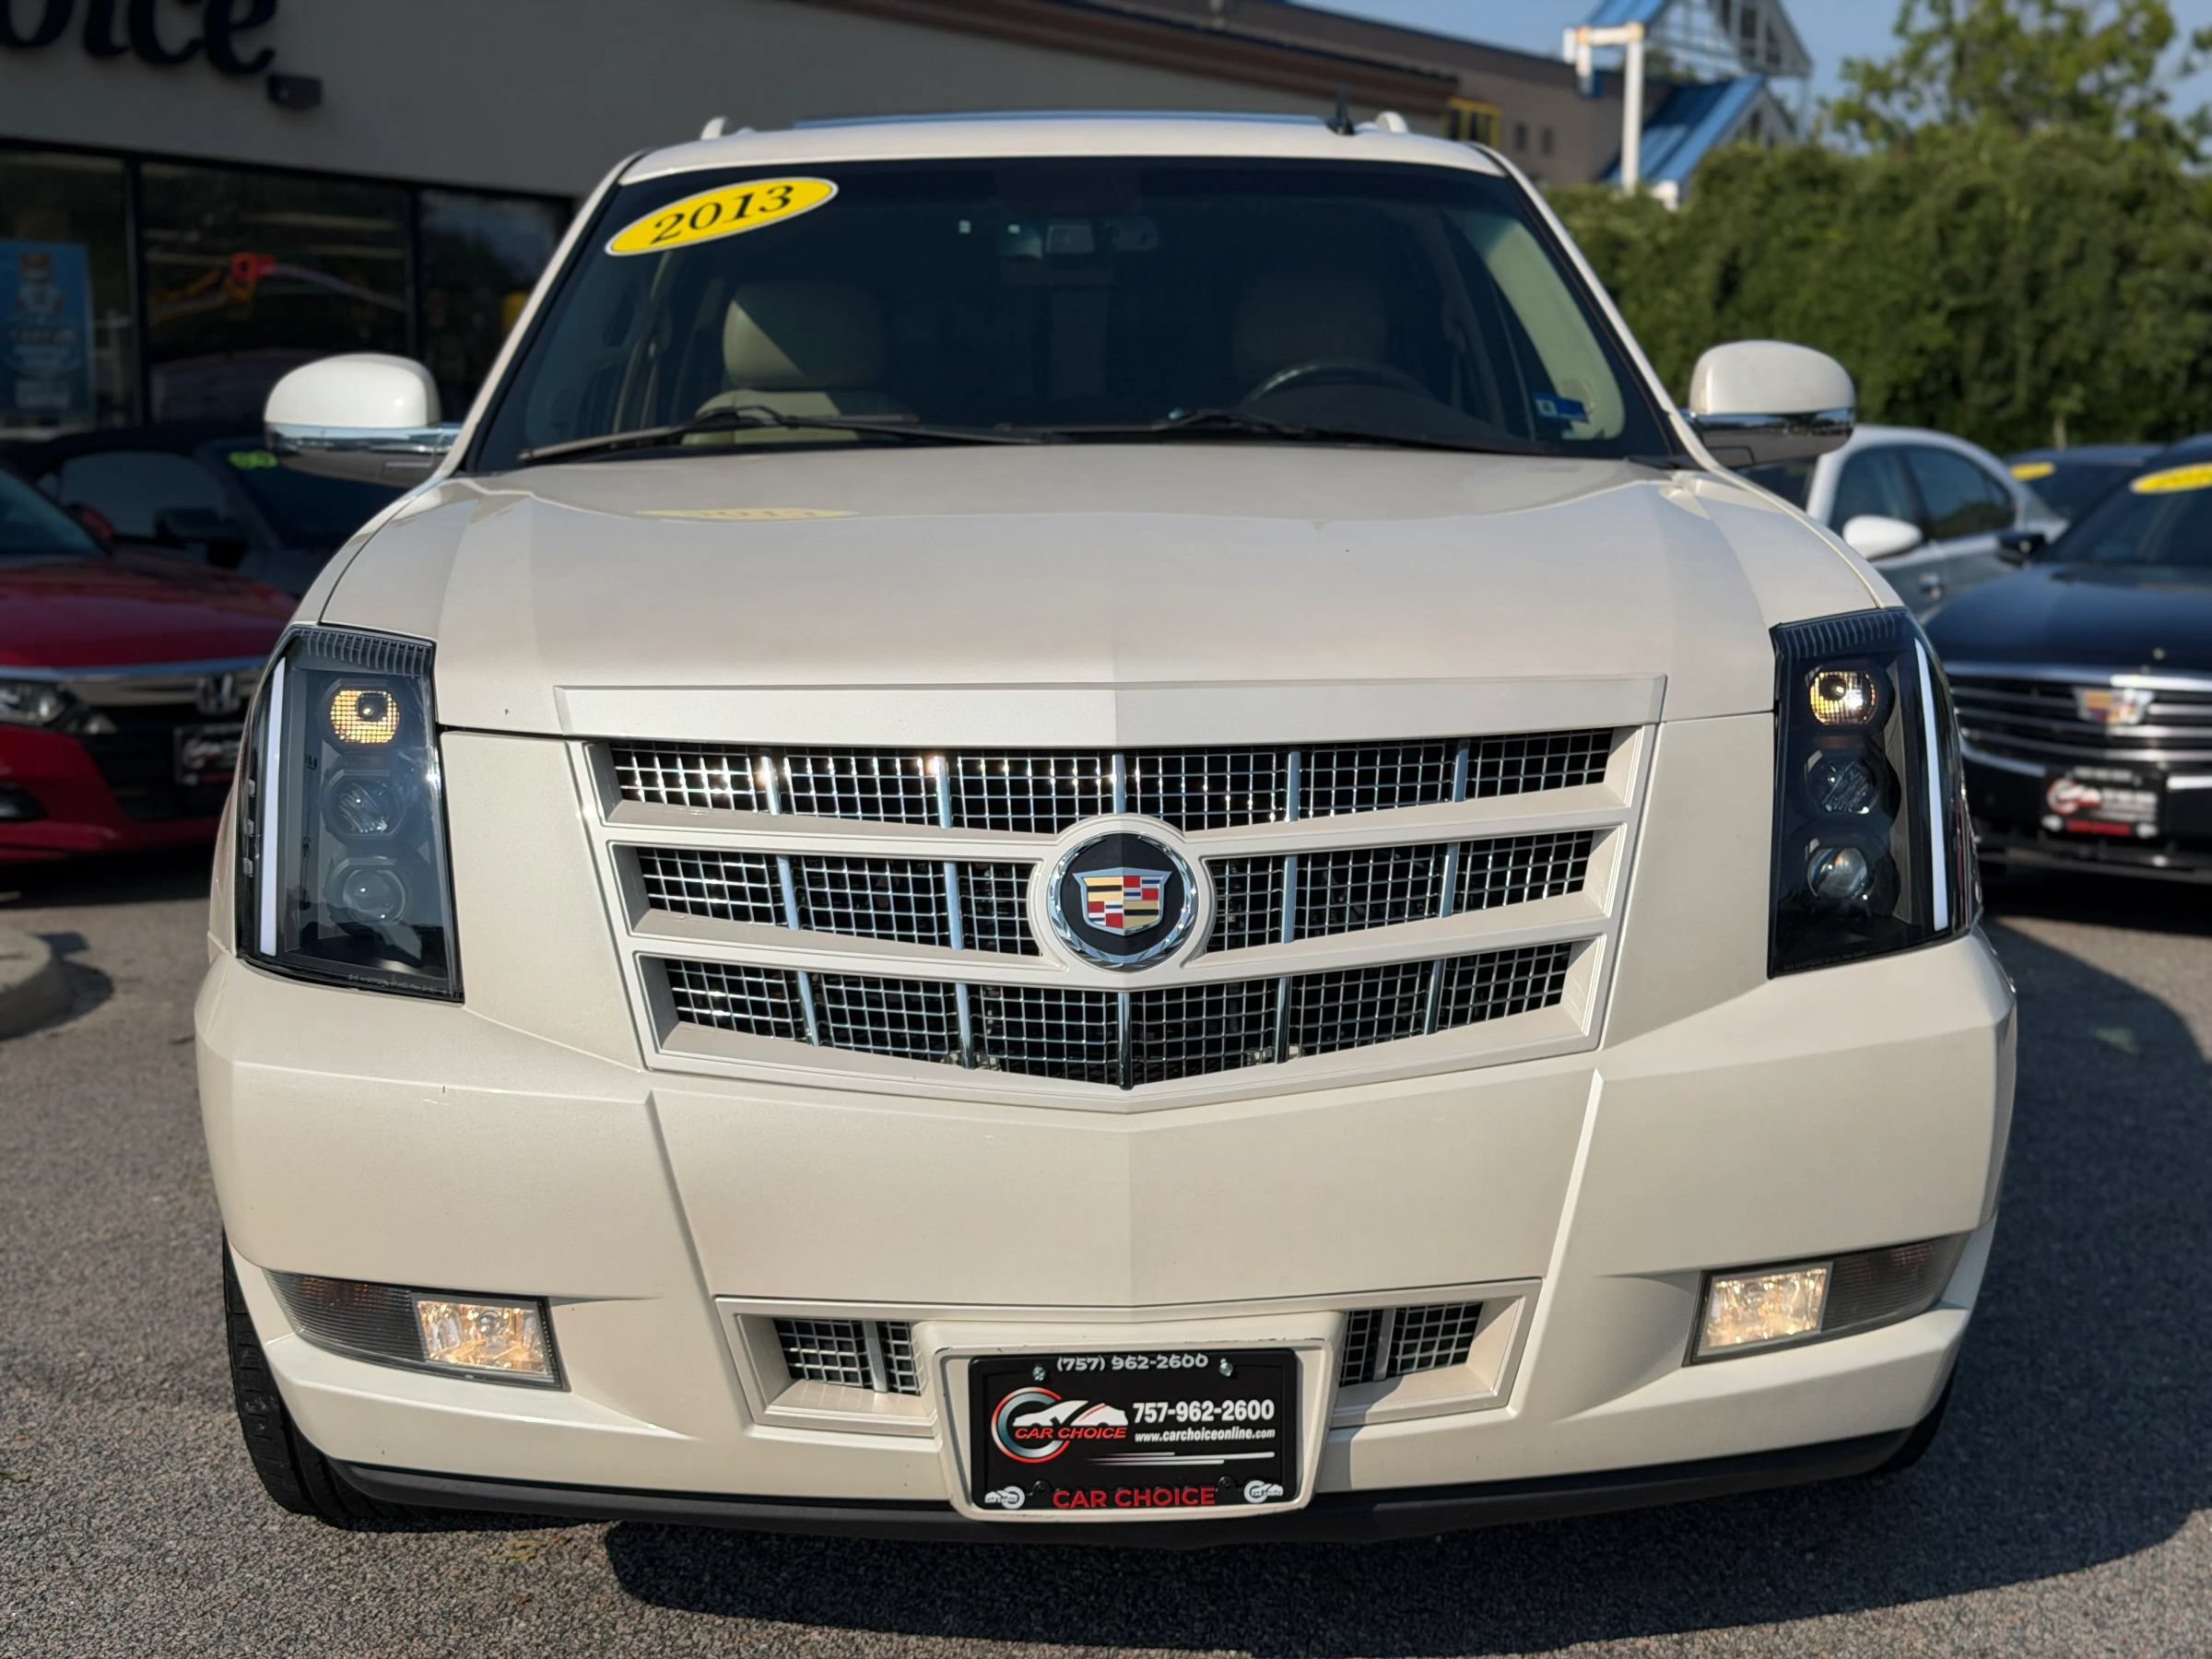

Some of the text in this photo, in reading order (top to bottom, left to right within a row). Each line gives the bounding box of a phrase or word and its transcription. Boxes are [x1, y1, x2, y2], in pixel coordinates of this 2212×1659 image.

[649, 185, 794, 245] 2013
[1056, 1354, 1208, 1371] (757) 962-2600
[1133, 1399, 1275, 1424] 757-962-2600
[1015, 1427, 1127, 1440] CAR CHOICE
[1135, 1426, 1276, 1442] www.carchoiceonline.com
[1053, 1488, 1217, 1510] CAR CHOICE
